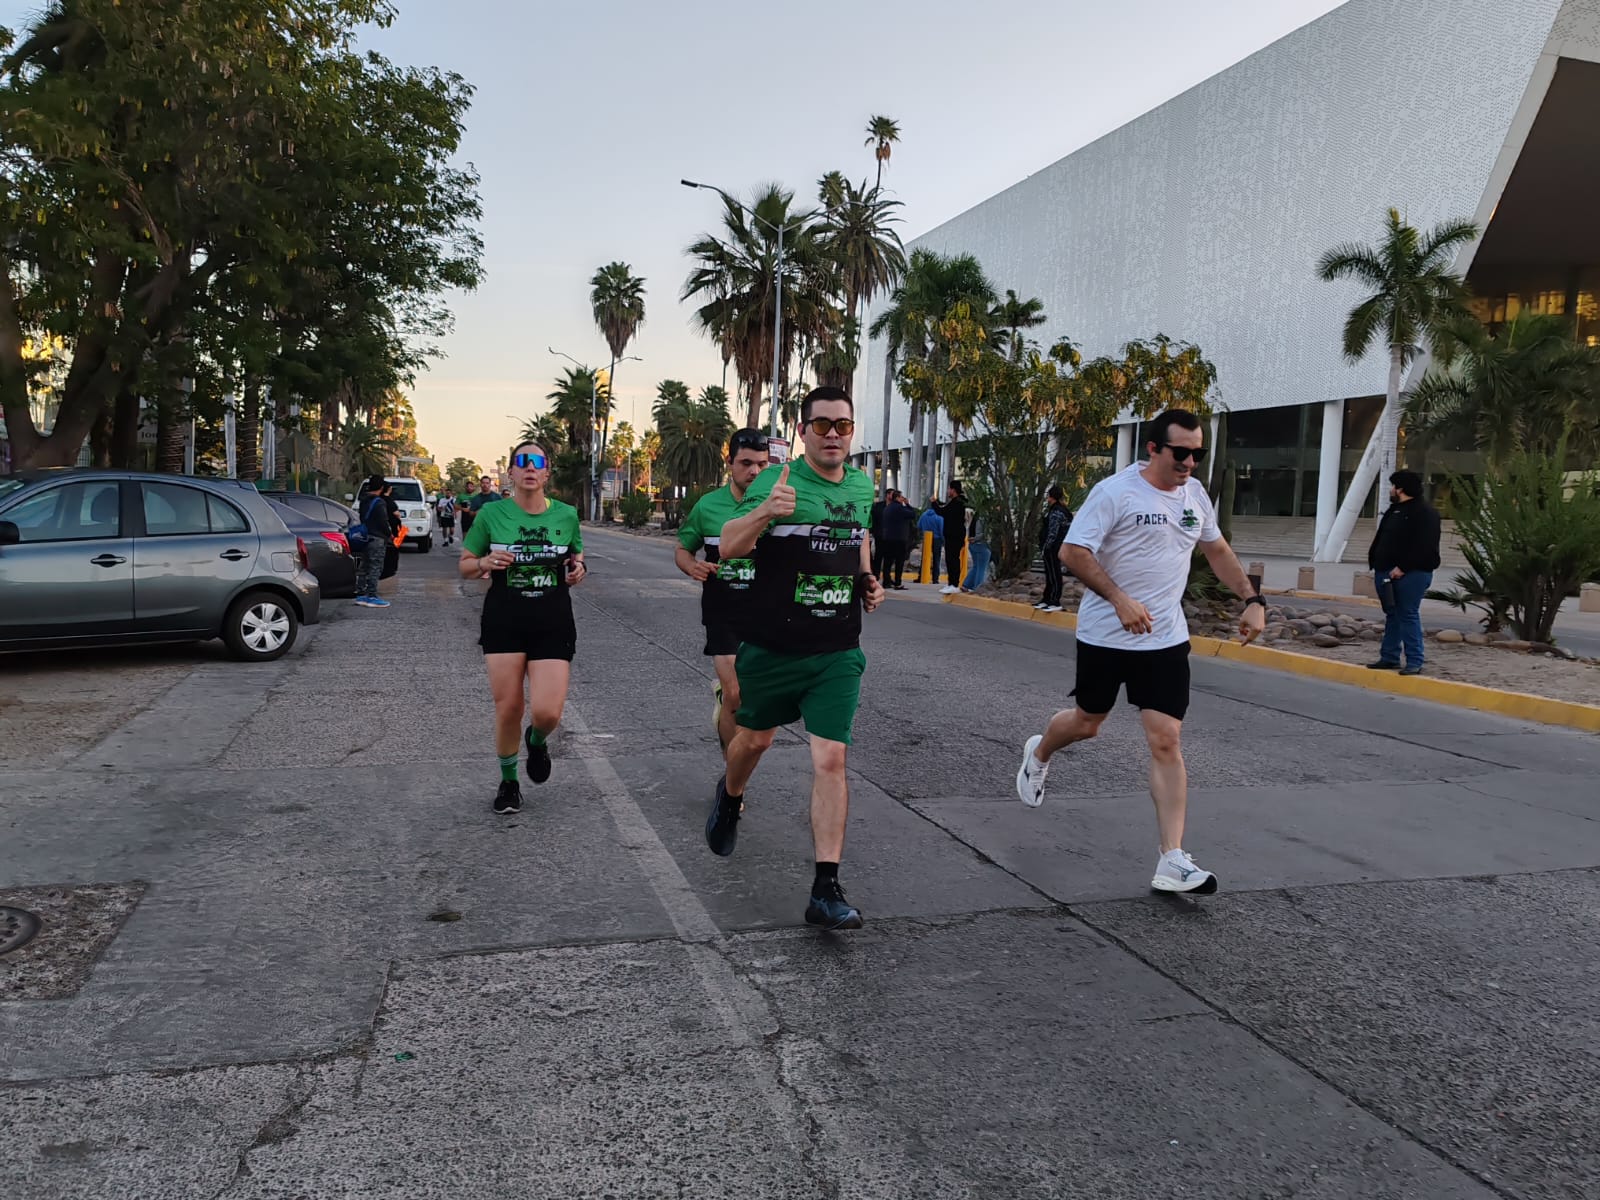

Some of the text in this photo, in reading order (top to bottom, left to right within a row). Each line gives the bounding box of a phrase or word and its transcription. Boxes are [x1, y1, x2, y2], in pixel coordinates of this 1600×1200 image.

[1136, 513, 1168, 525] PACER
[811, 537, 837, 551] vitu
[515, 552, 533, 562] itu
[532, 575, 552, 587] 174
[823, 589, 850, 604] 002
